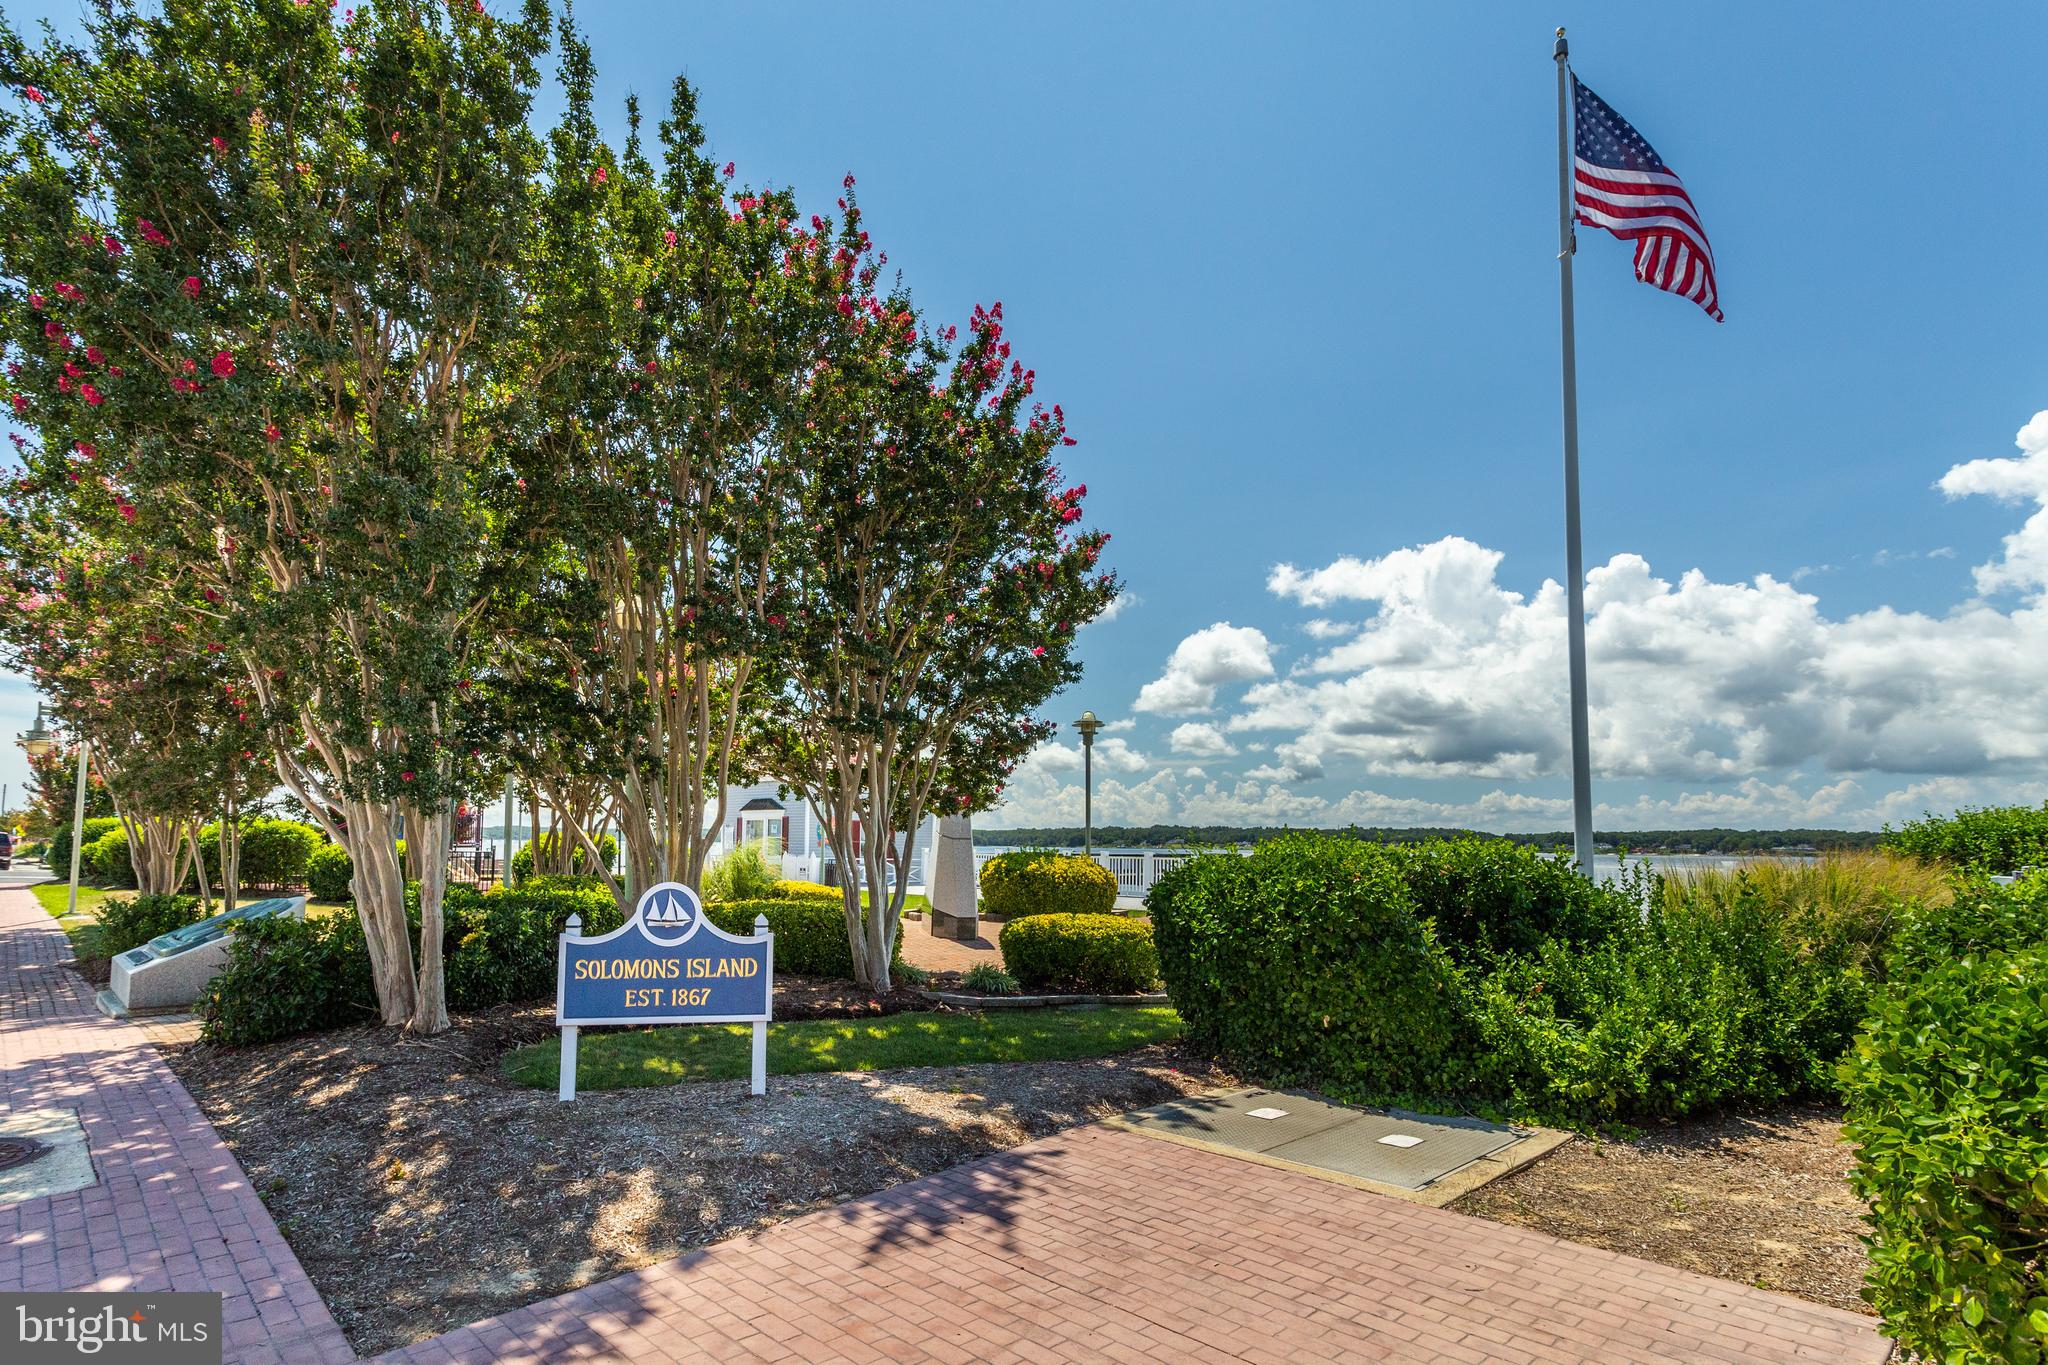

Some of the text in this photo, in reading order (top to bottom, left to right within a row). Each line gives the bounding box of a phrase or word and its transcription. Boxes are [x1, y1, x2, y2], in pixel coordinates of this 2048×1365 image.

[575, 957, 758, 980] SOLOMONS ISLAND
[625, 988, 712, 1008] EST. 1867
